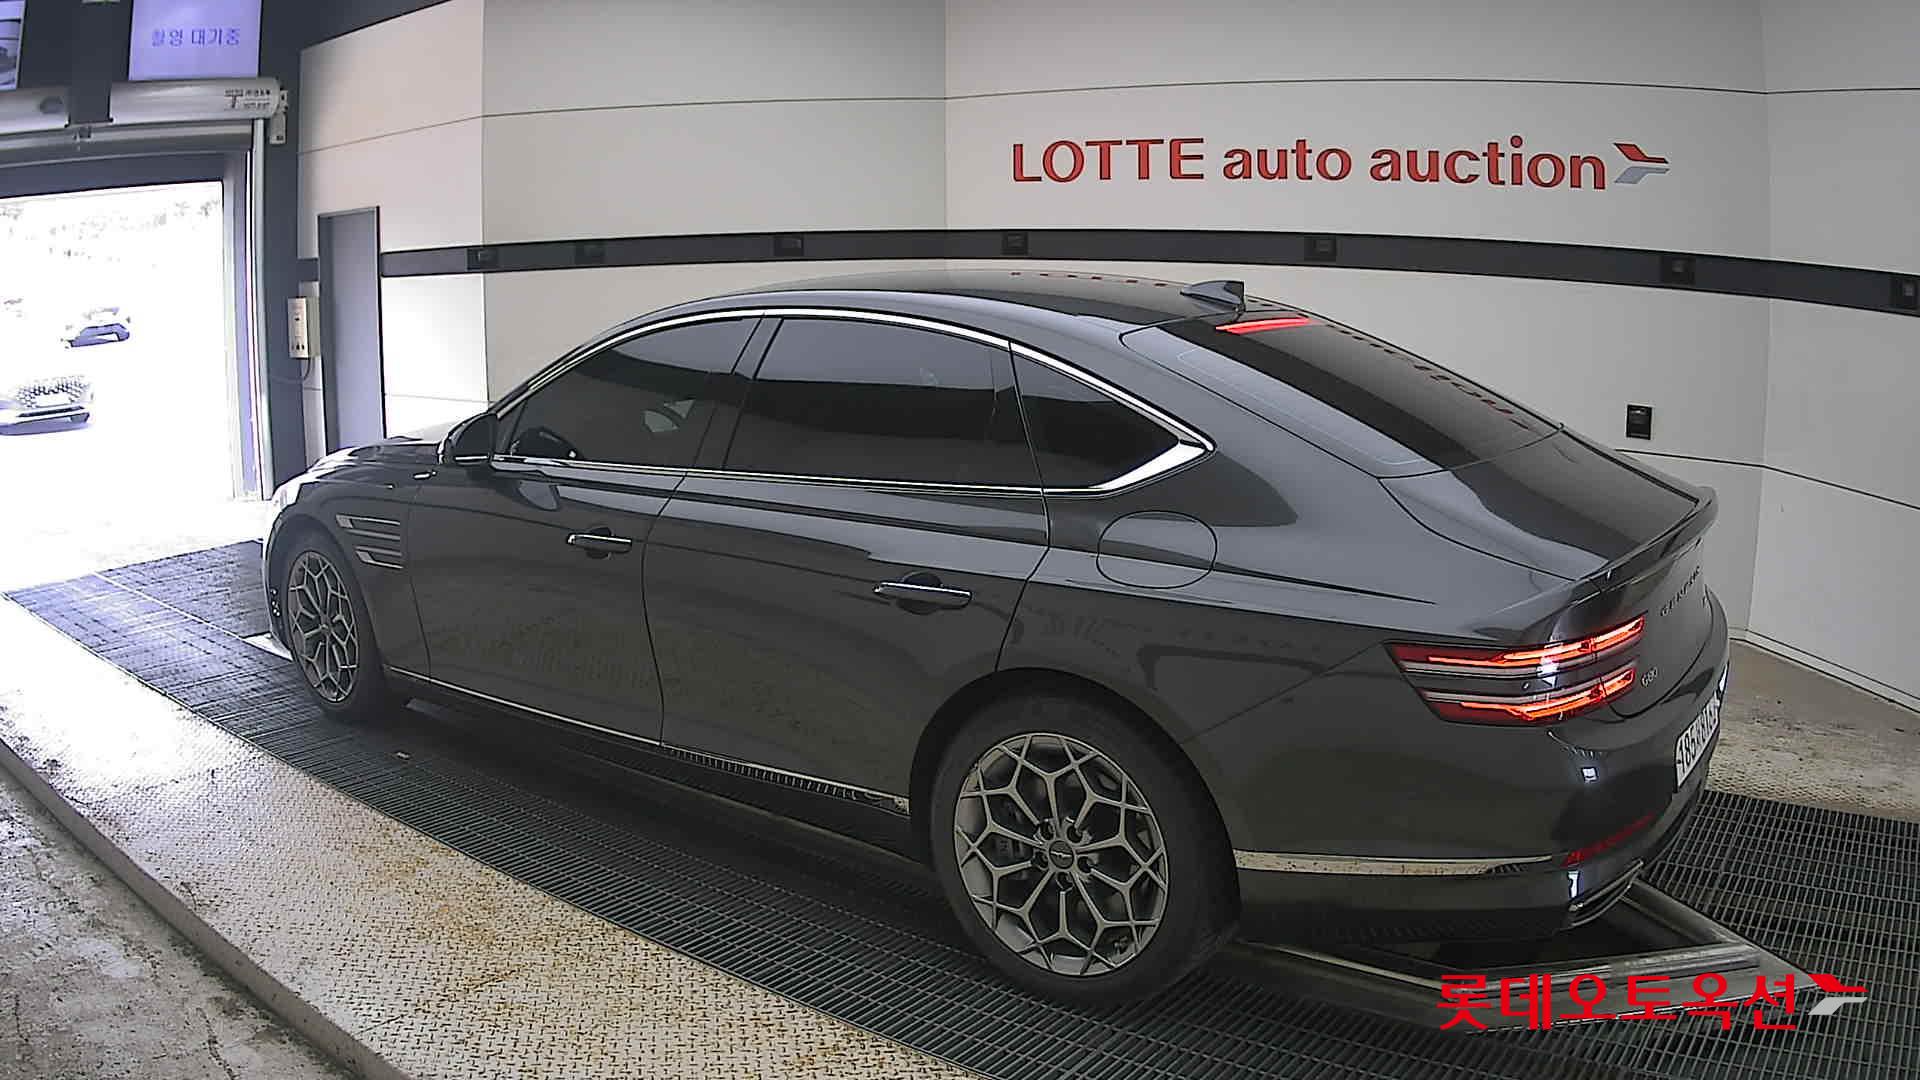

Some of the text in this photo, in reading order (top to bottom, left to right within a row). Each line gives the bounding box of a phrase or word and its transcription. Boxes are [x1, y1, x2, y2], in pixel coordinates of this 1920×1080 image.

[191, 27, 241, 46] 대기중
[1012, 135, 1606, 190] LOTTE auto auction
